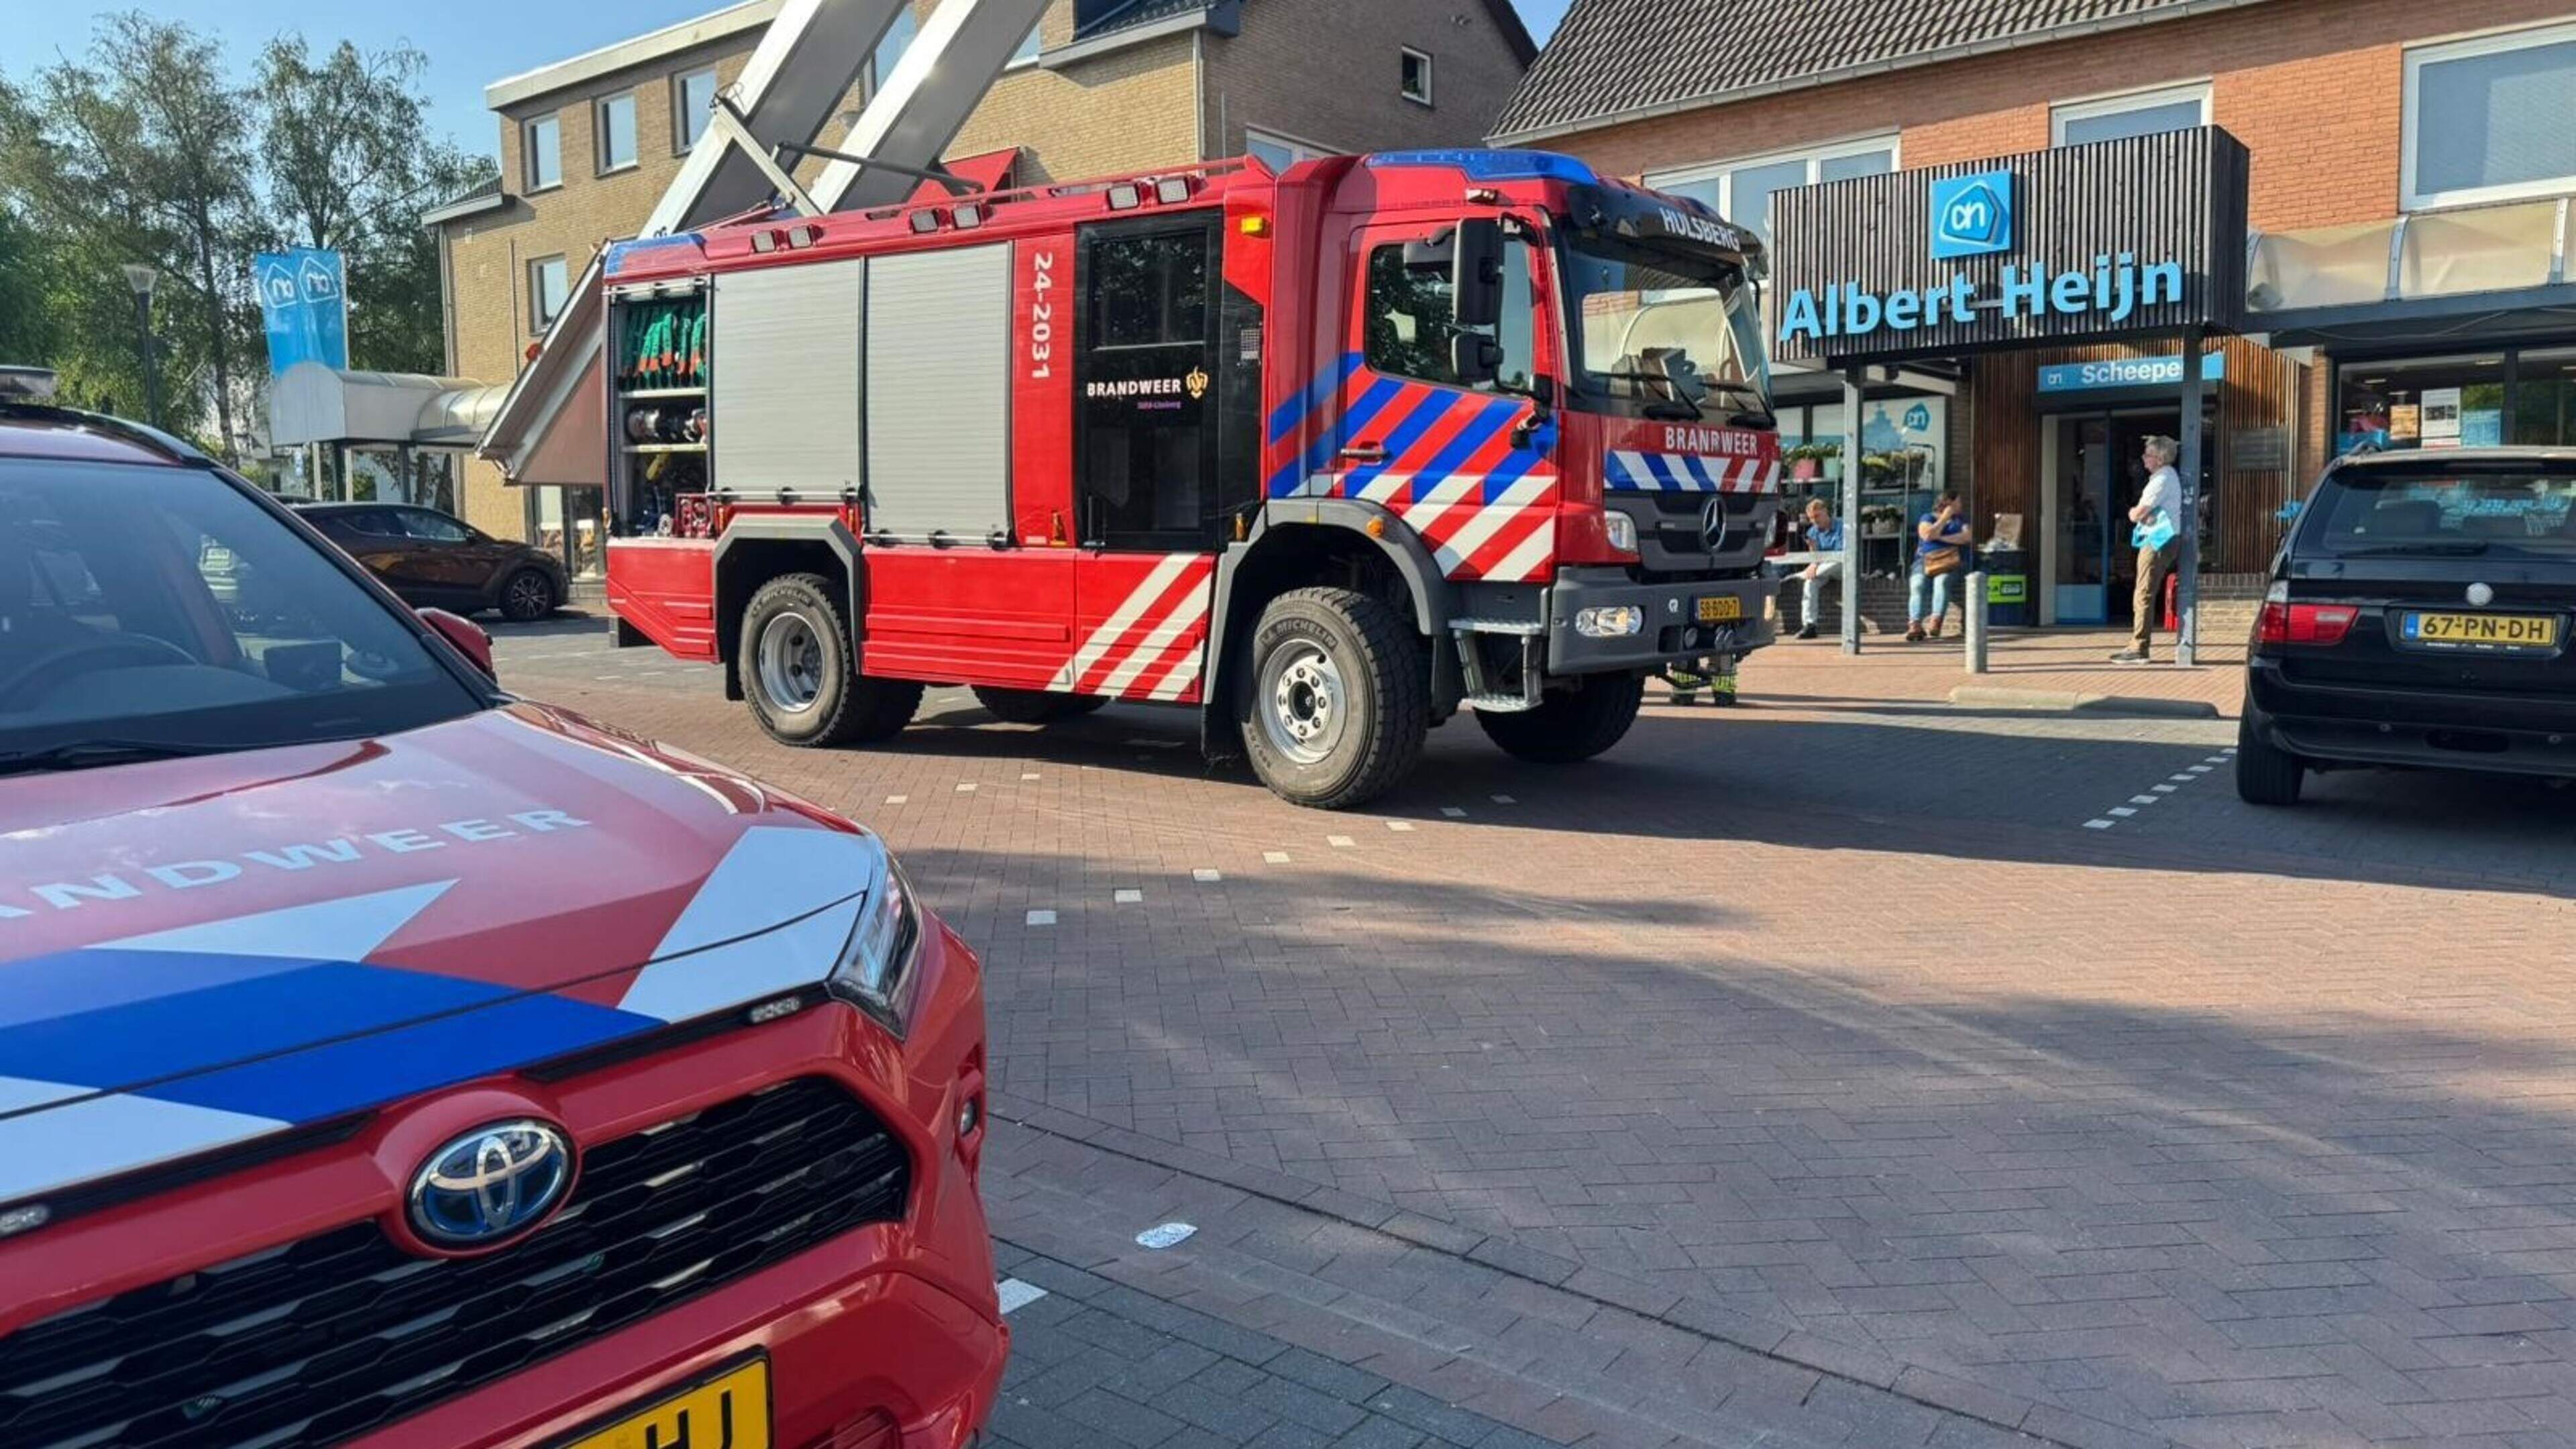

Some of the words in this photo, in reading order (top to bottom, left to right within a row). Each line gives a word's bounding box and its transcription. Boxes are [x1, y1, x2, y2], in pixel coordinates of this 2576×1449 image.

[1659, 207, 1740, 252] HULSBERG
[1032, 252, 1053, 378] 24-2031
[1780, 272, 1975, 341] Albert
[2002, 252, 2182, 322] Heijn
[1087, 378, 1181, 397] BRANDWEER
[1276, 618, 1338, 648] MICHELIN
[2424, 616, 2544, 639] 67-PN-DH
